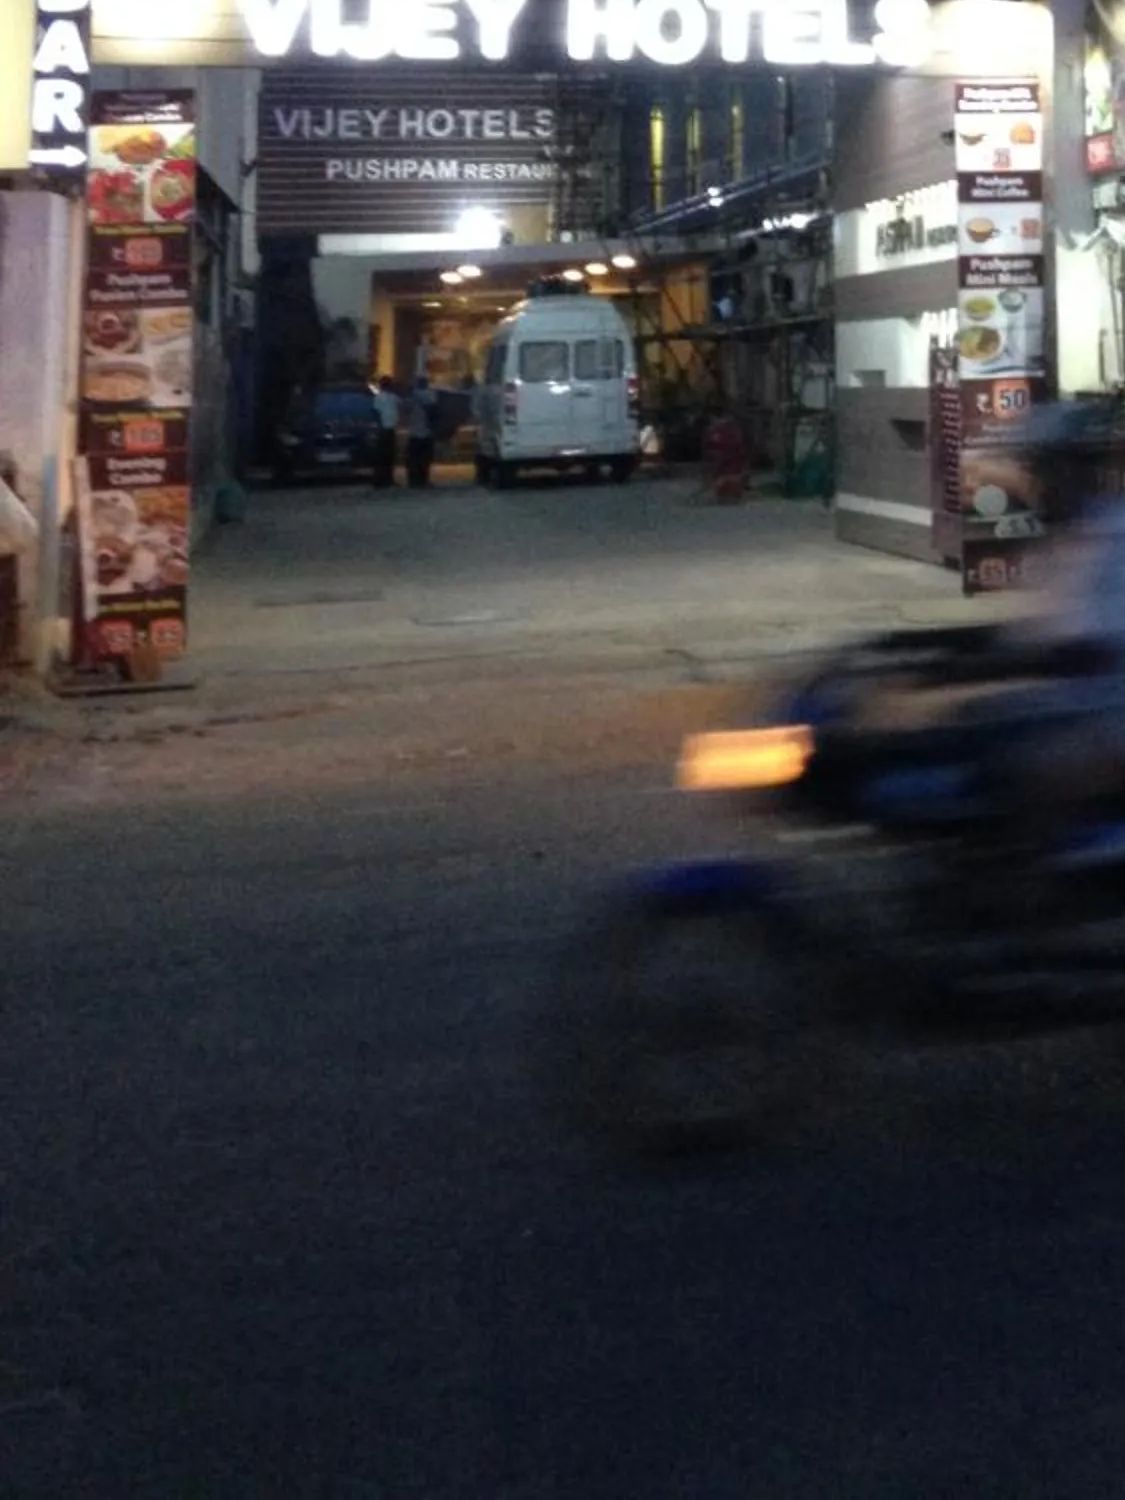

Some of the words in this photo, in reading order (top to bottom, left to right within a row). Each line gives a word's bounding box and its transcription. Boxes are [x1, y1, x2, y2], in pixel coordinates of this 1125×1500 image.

[272, 107, 388, 138] VIJEY
[398, 108, 555, 140] HOTELS
[325, 157, 458, 182] PUSHPAM
